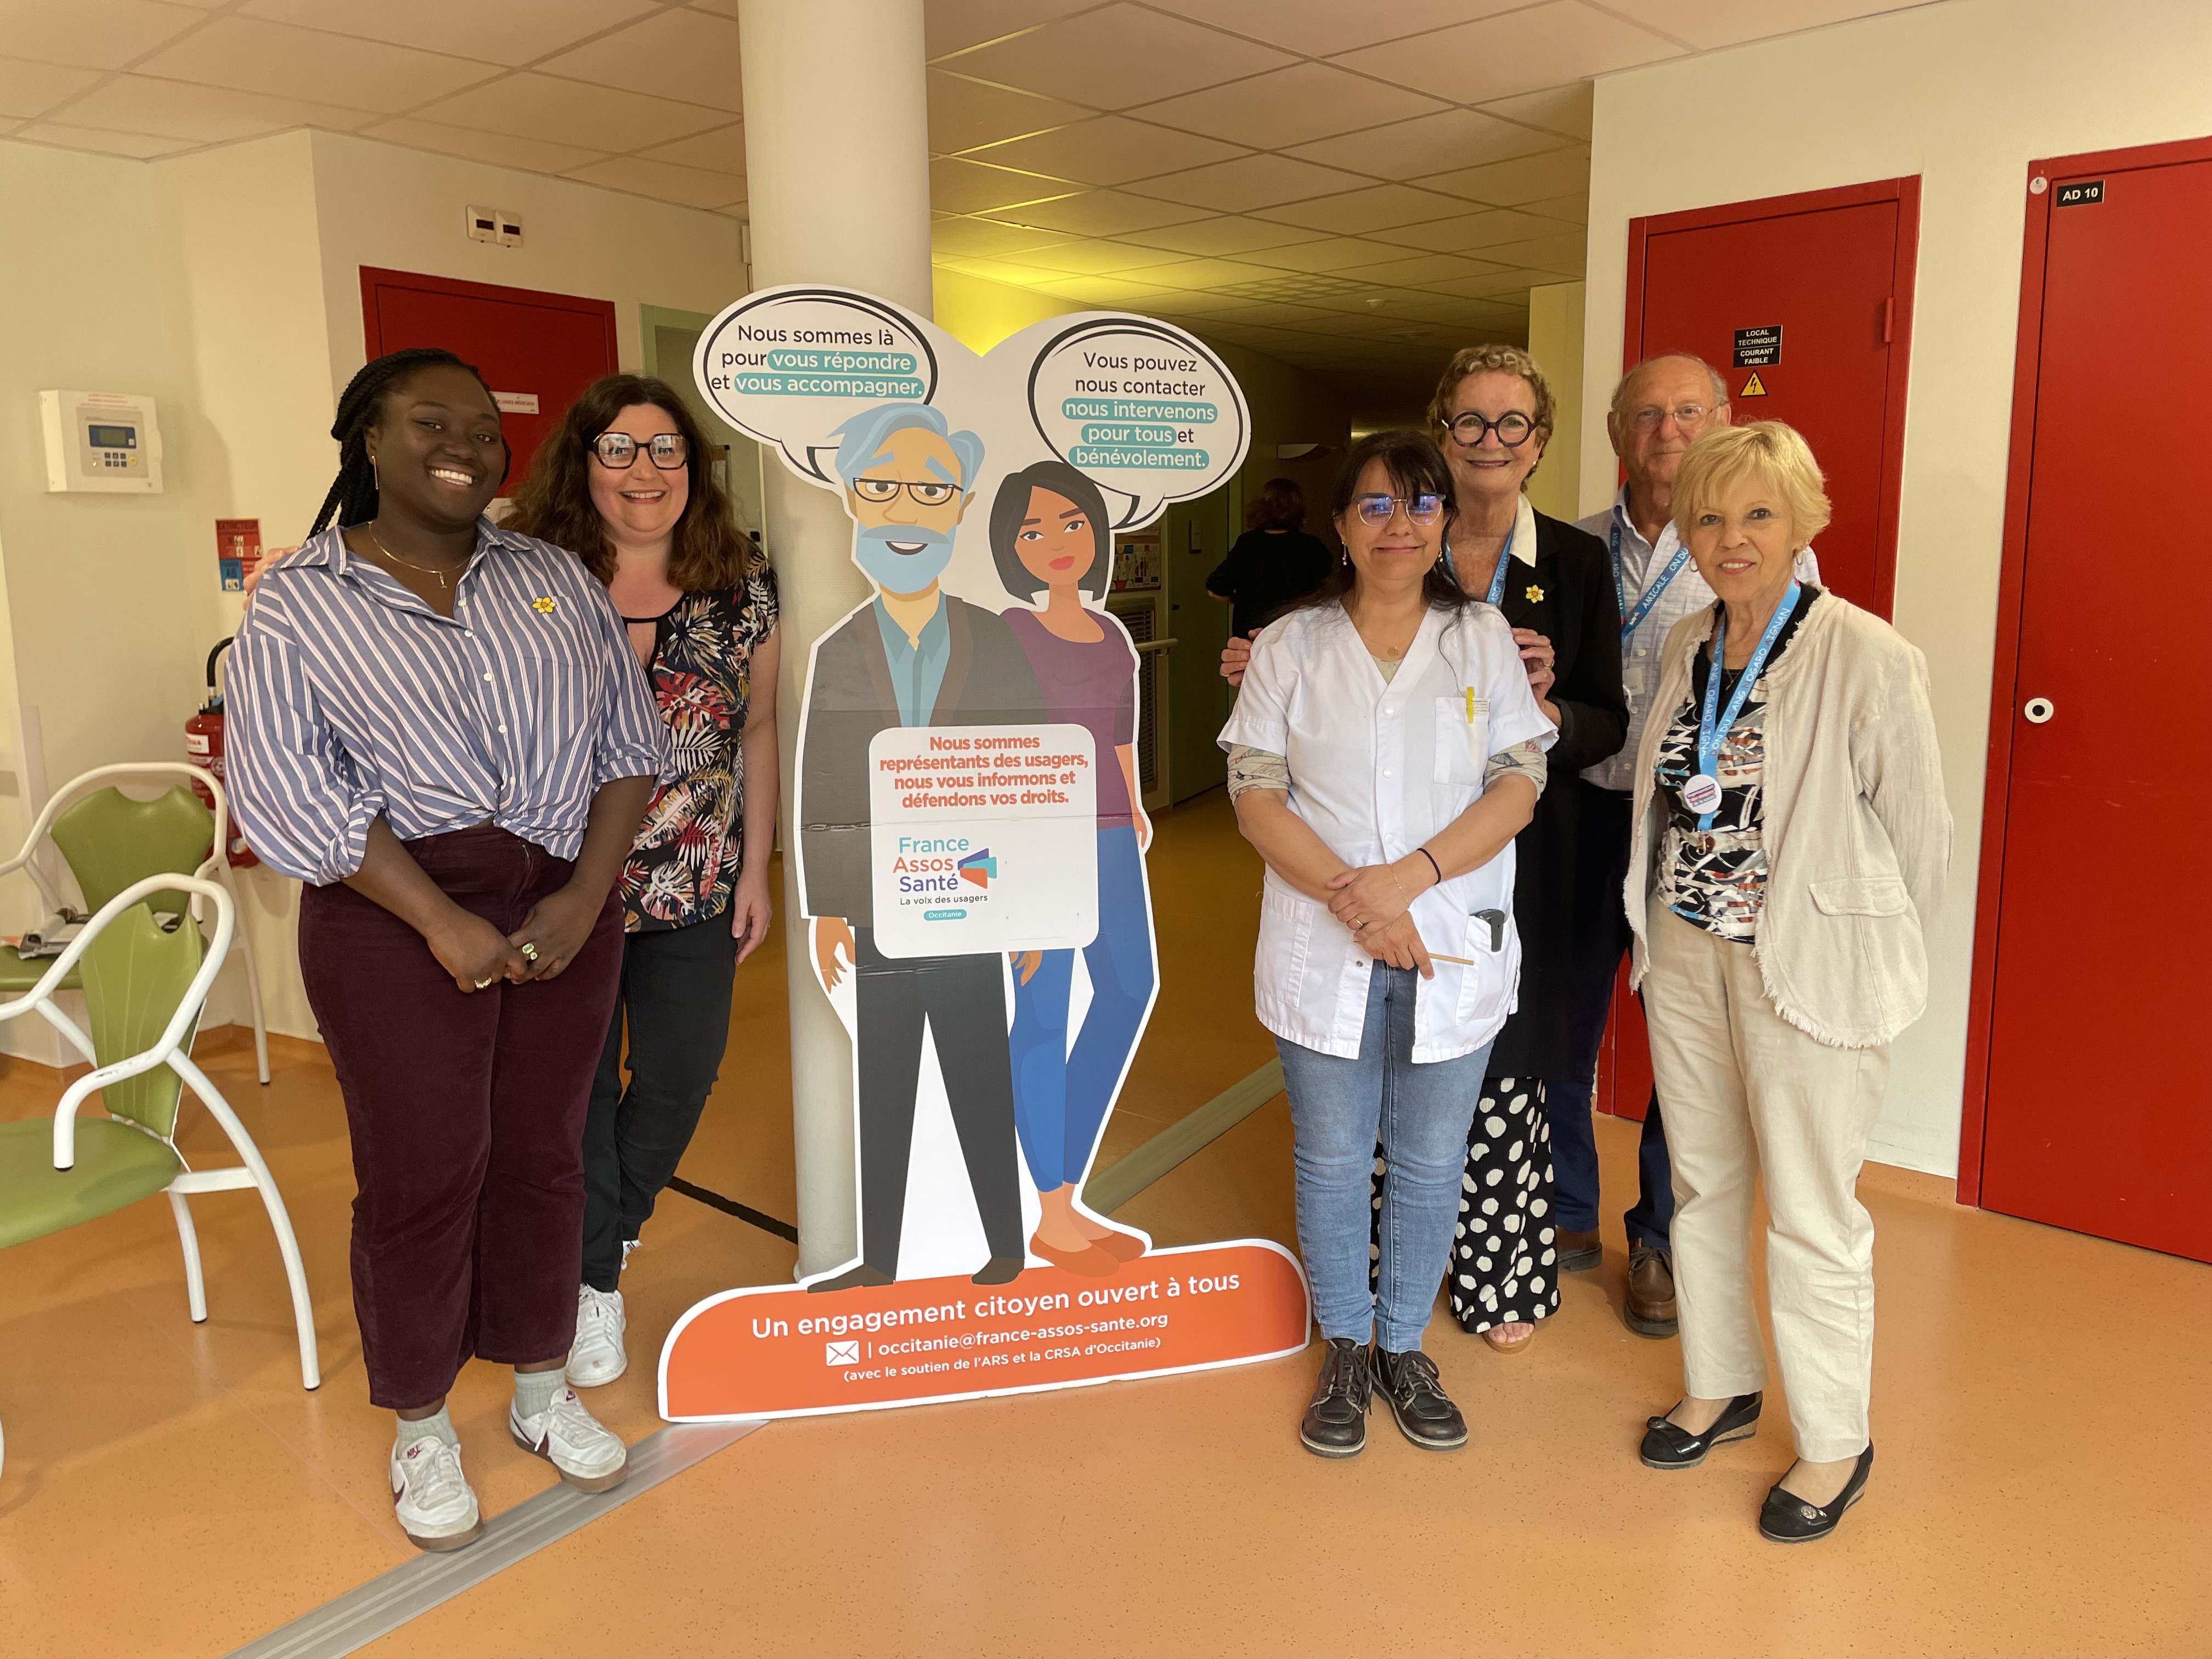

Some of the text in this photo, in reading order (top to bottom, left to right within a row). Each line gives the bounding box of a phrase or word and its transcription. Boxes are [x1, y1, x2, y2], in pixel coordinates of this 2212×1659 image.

[2063, 187, 2098, 201] AD 10
[738, 325, 894, 345] Nous sommes là
[1738, 337, 1777, 346] TECHNIQUE
[722, 352, 911, 371] pour vous répondre
[1740, 348, 1774, 357] COURANT
[1084, 352, 1197, 373] Vous pouvez
[712, 375, 923, 396] et vous accompagner.
[1075, 379, 1205, 396] nous contacter
[1065, 402, 1214, 420] nous intervenons
[1088, 426, 1194, 443] pour tous et
[1076, 448, 1205, 467] bénévolement.
[1643, 575, 1669, 609] AMICALE
[1709, 608, 1791, 756] DON DU SANG NOGARO AIGNAN
[1703, 682, 1717, 721] NOGARO
[930, 736, 1040, 751] Nous sommes
[880, 753, 1088, 774] représentants des usagers,
[895, 771, 1075, 789] nous vous informons et
[902, 789, 1069, 808] défendons vos droits.
[899, 837, 969, 853] France
[893, 856, 953, 873] Assos
[900, 873, 958, 892] Santé
[954, 895, 988, 903] usagers
[752, 1274, 1239, 1338] Un engagement citoyen ouvert à tous
[878, 1314, 1169, 1356] occitanie@france-assos-sante.org
[844, 1369, 881, 1383] (avec
[885, 1364, 897, 1377] le
[901, 1362, 949, 1375] soutien
[954, 1359, 970, 1370] de
[1013, 1352, 1026, 1363] et
[1030, 1351, 1041, 1362] la
[1045, 1347, 1081, 1360] CRSA
